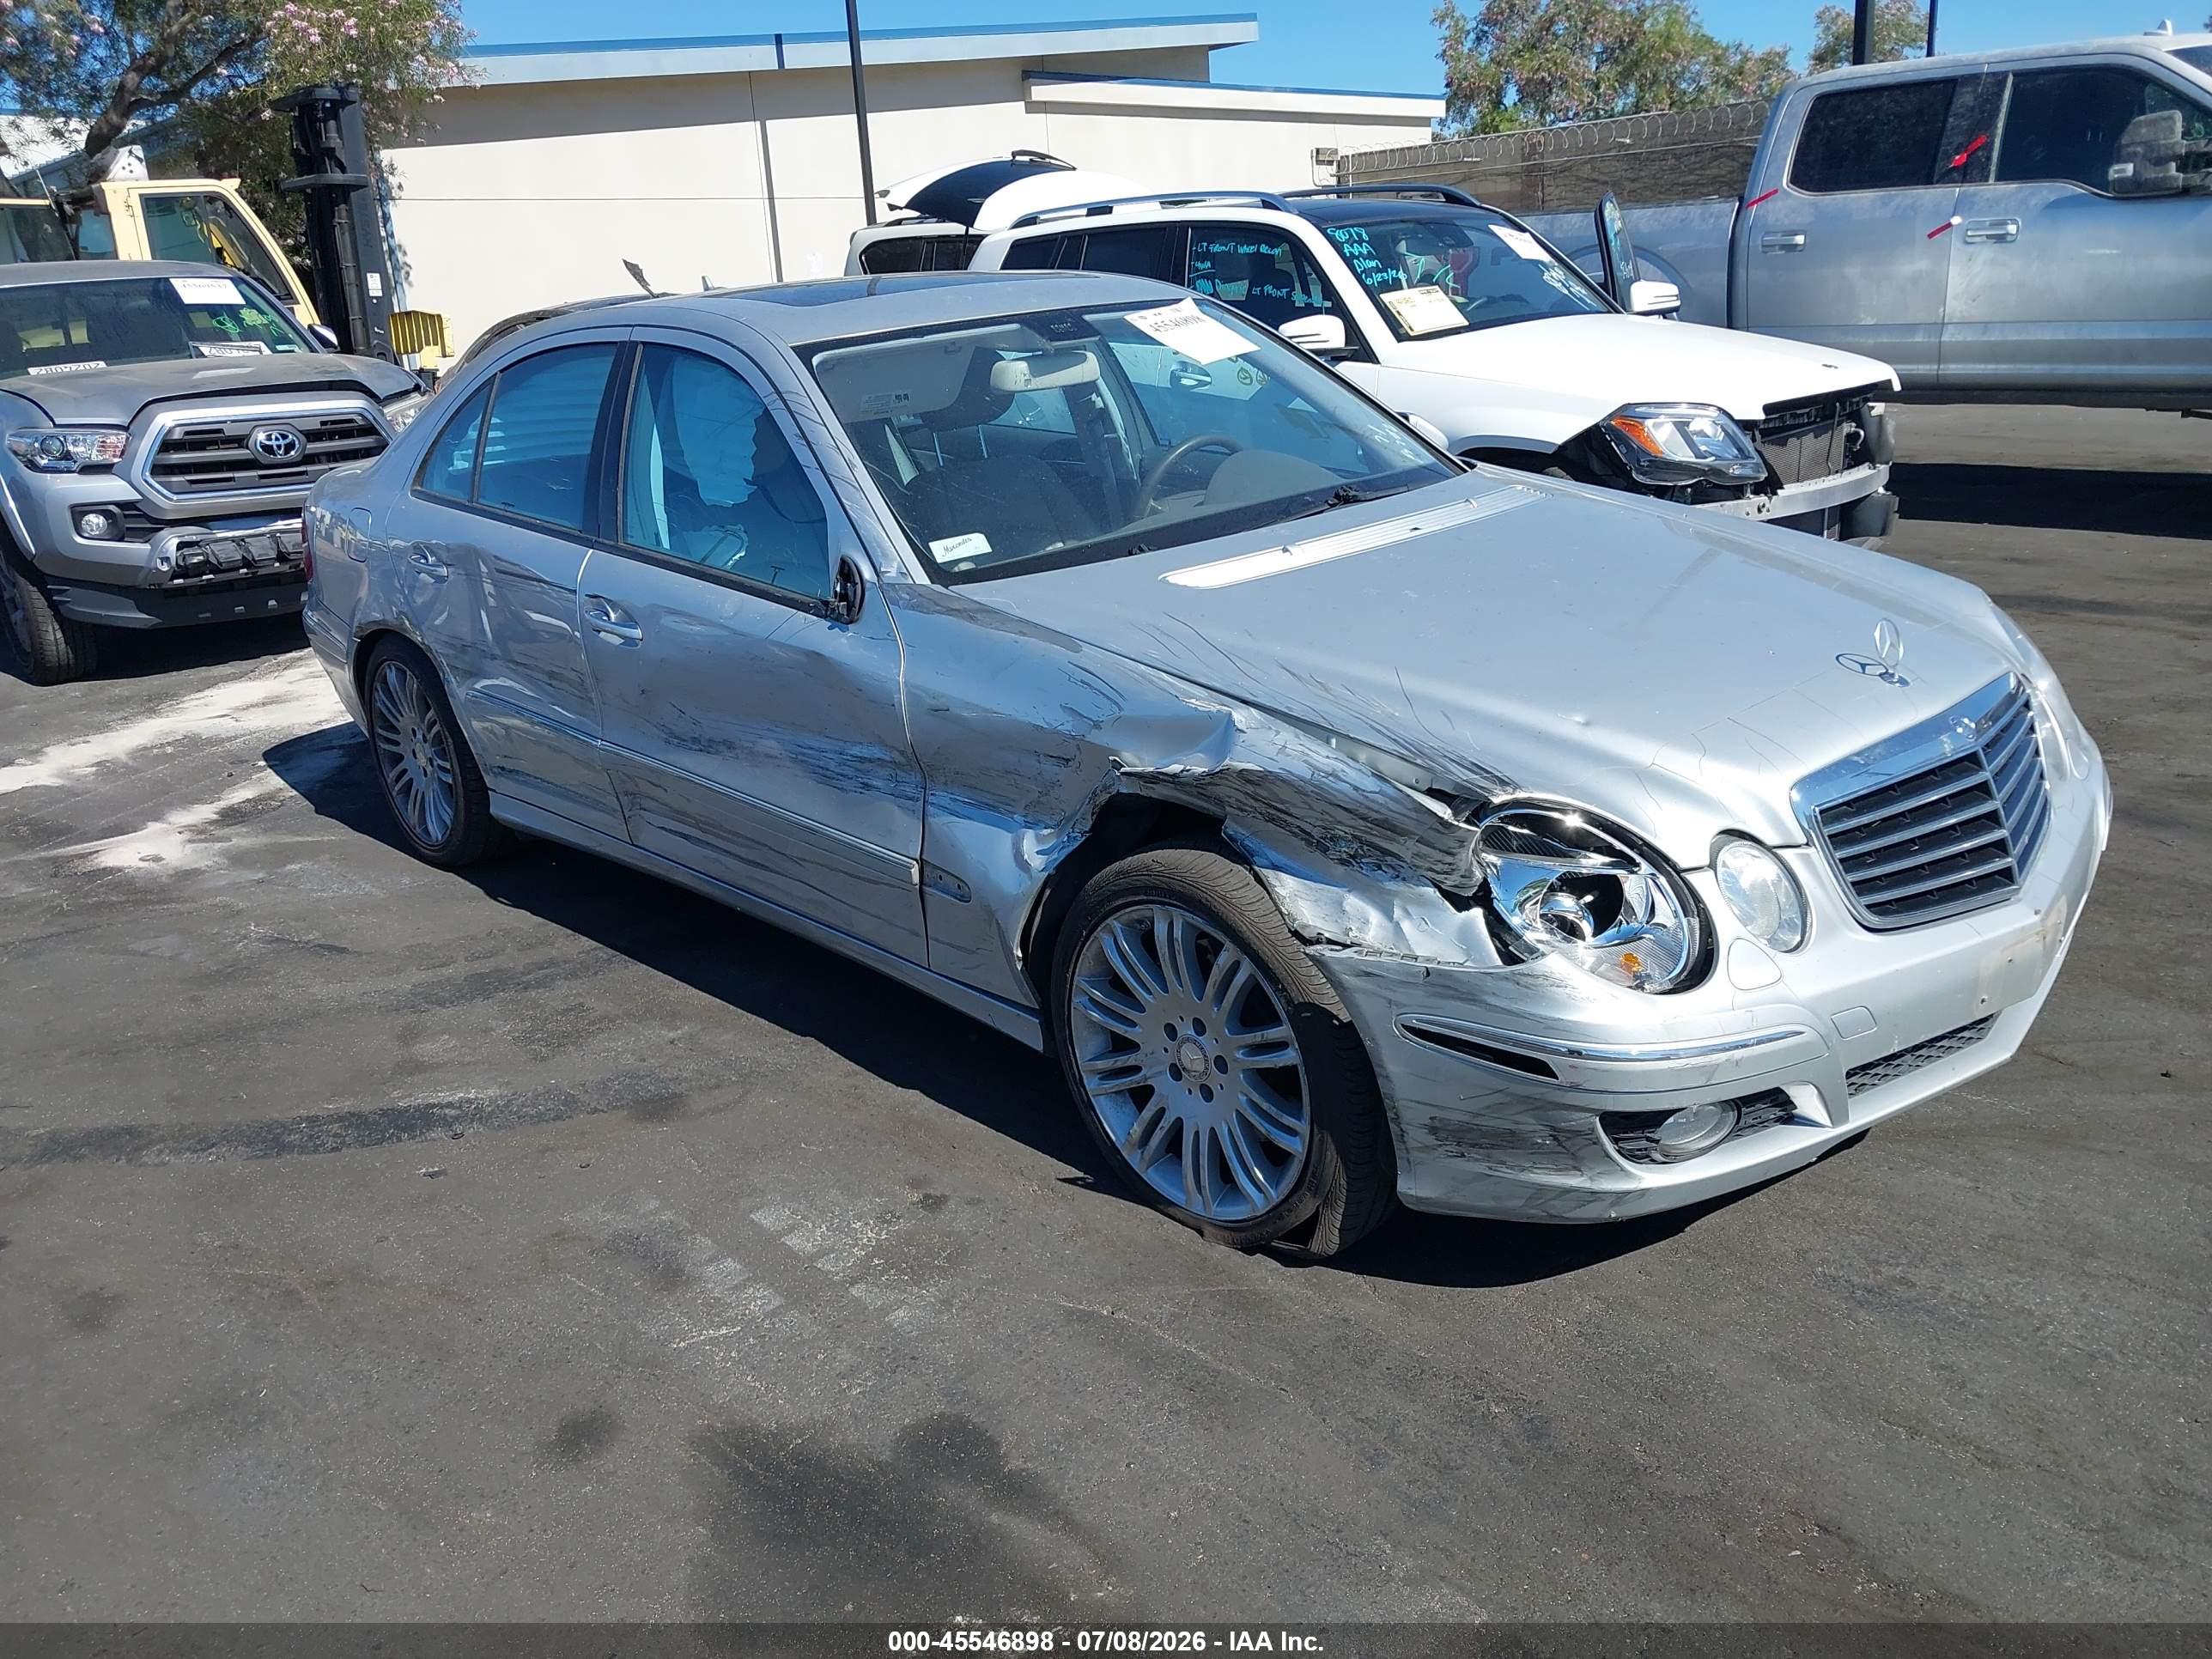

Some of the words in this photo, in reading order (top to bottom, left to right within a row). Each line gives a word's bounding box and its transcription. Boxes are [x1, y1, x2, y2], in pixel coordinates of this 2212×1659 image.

[1209, 243, 1236, 254] FRONT
[1344, 242, 1376, 257] AAA
[1264, 284, 1290, 300] FRONT
